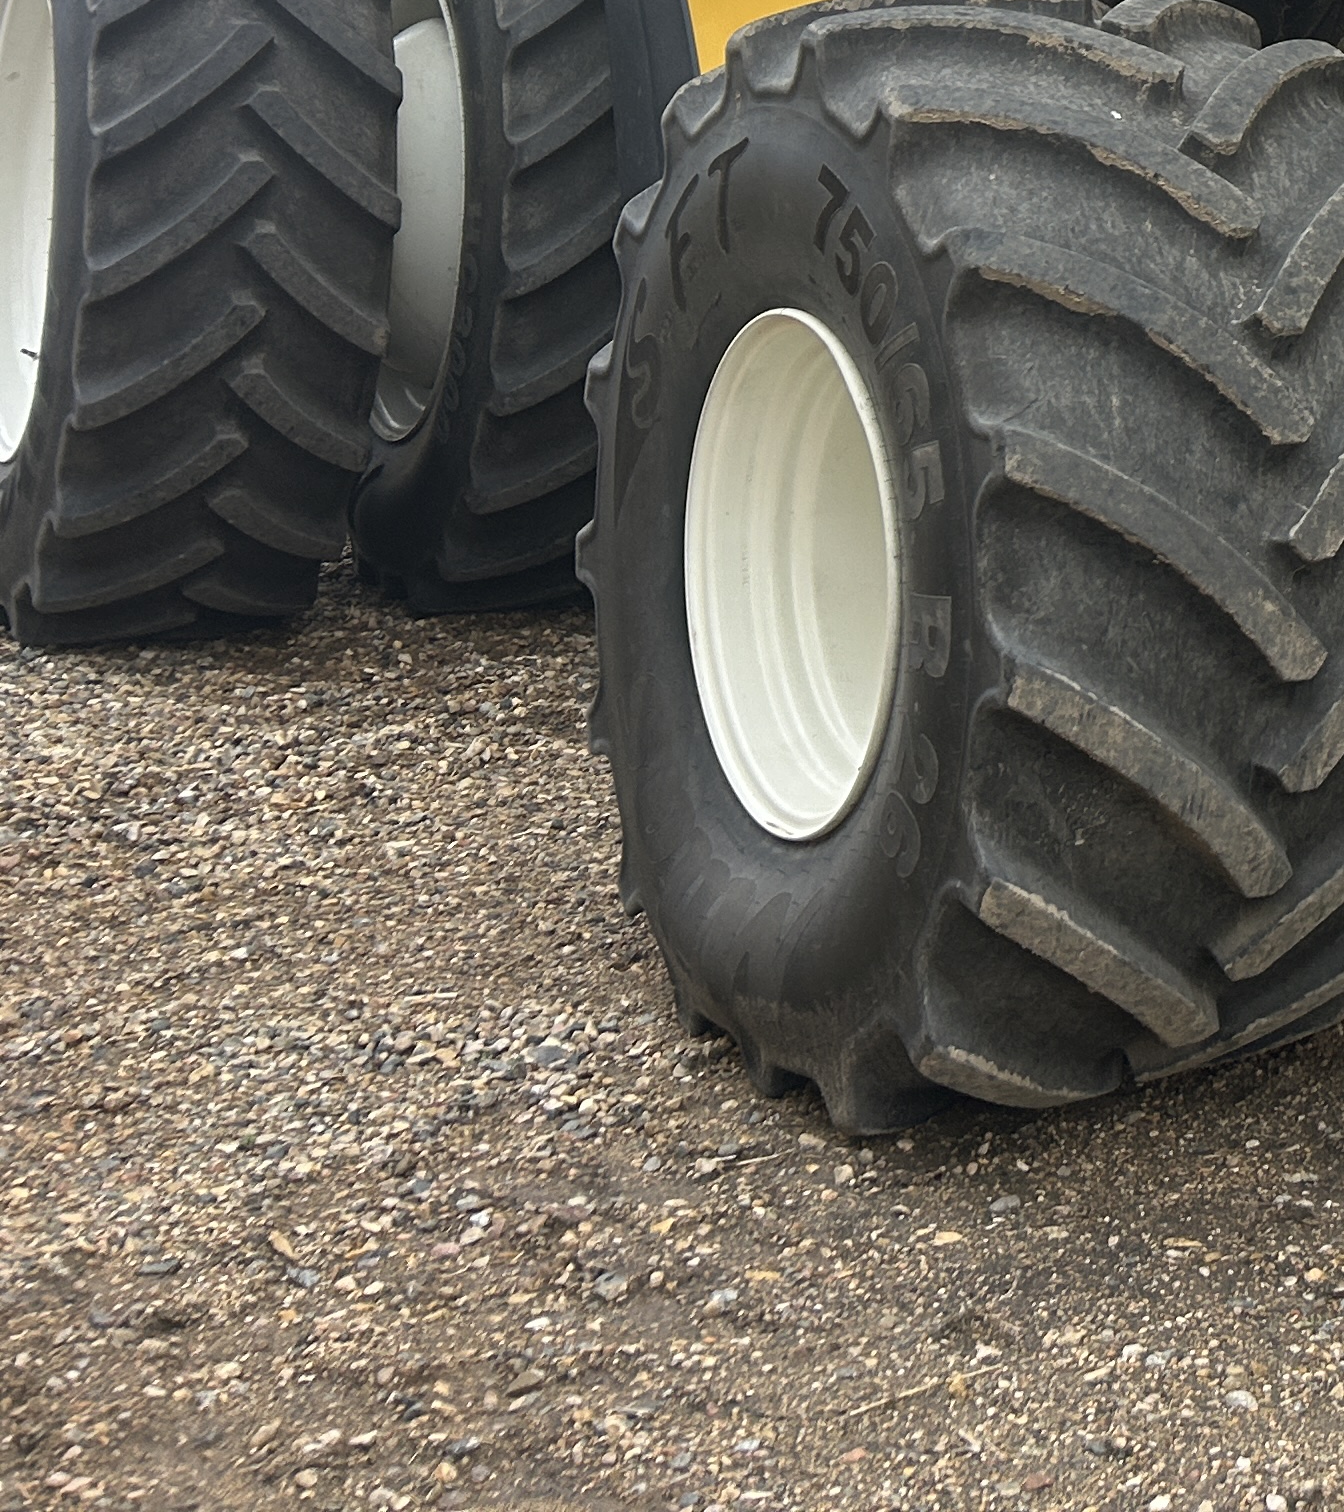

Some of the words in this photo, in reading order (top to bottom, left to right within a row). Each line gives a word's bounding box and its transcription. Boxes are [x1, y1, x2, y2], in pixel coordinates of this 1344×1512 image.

[812, 162, 945, 521] 750/65
[909, 593, 952, 678] R
[880, 714, 939, 878] 26
